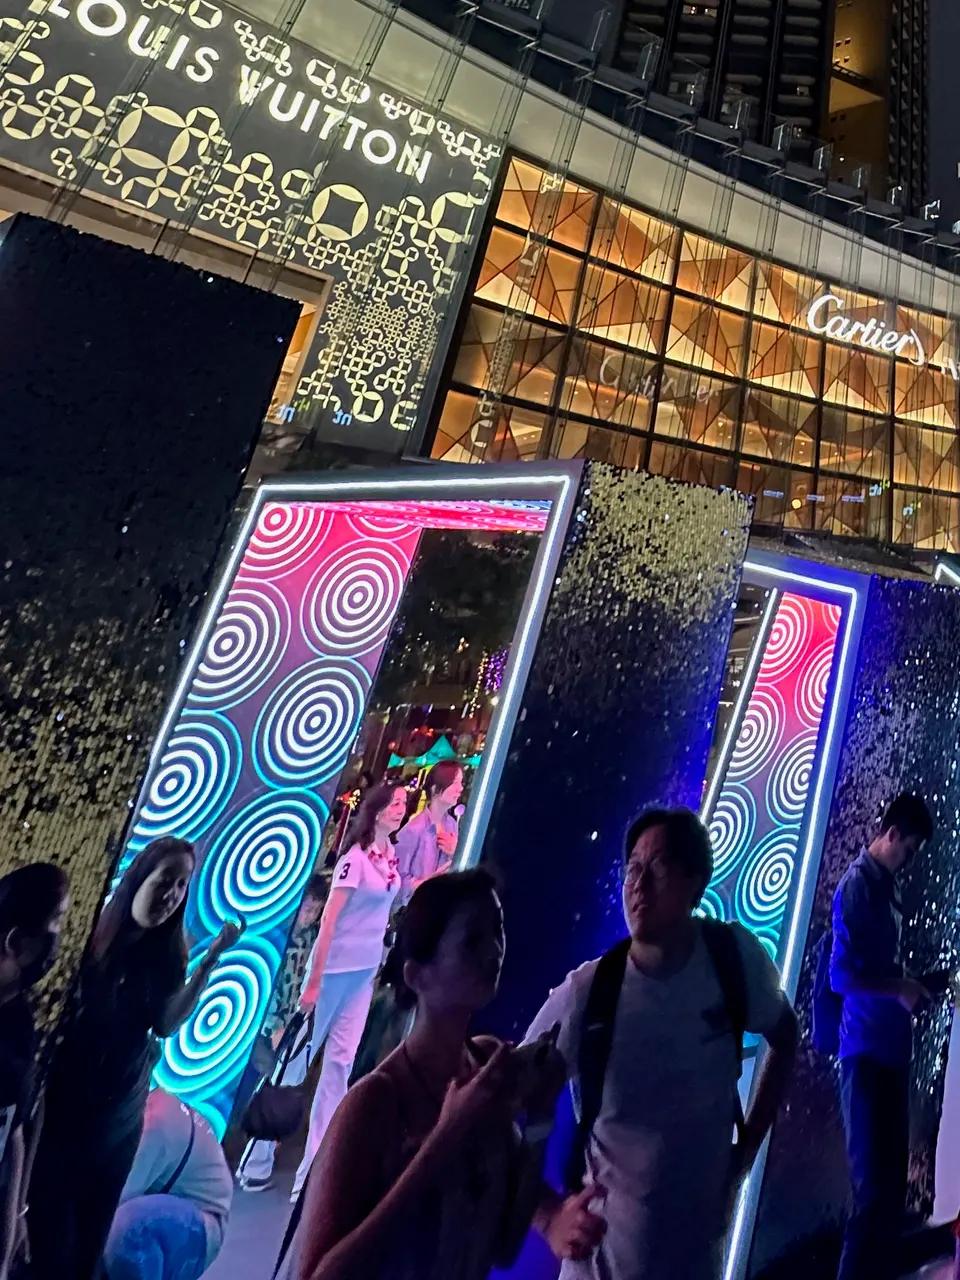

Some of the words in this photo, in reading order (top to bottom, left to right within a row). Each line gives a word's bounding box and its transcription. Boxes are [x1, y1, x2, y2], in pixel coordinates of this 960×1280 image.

[239, 64, 433, 184] VUITTON
[807, 294, 925, 366] Cartier
[339, 862, 351, 880] 3
